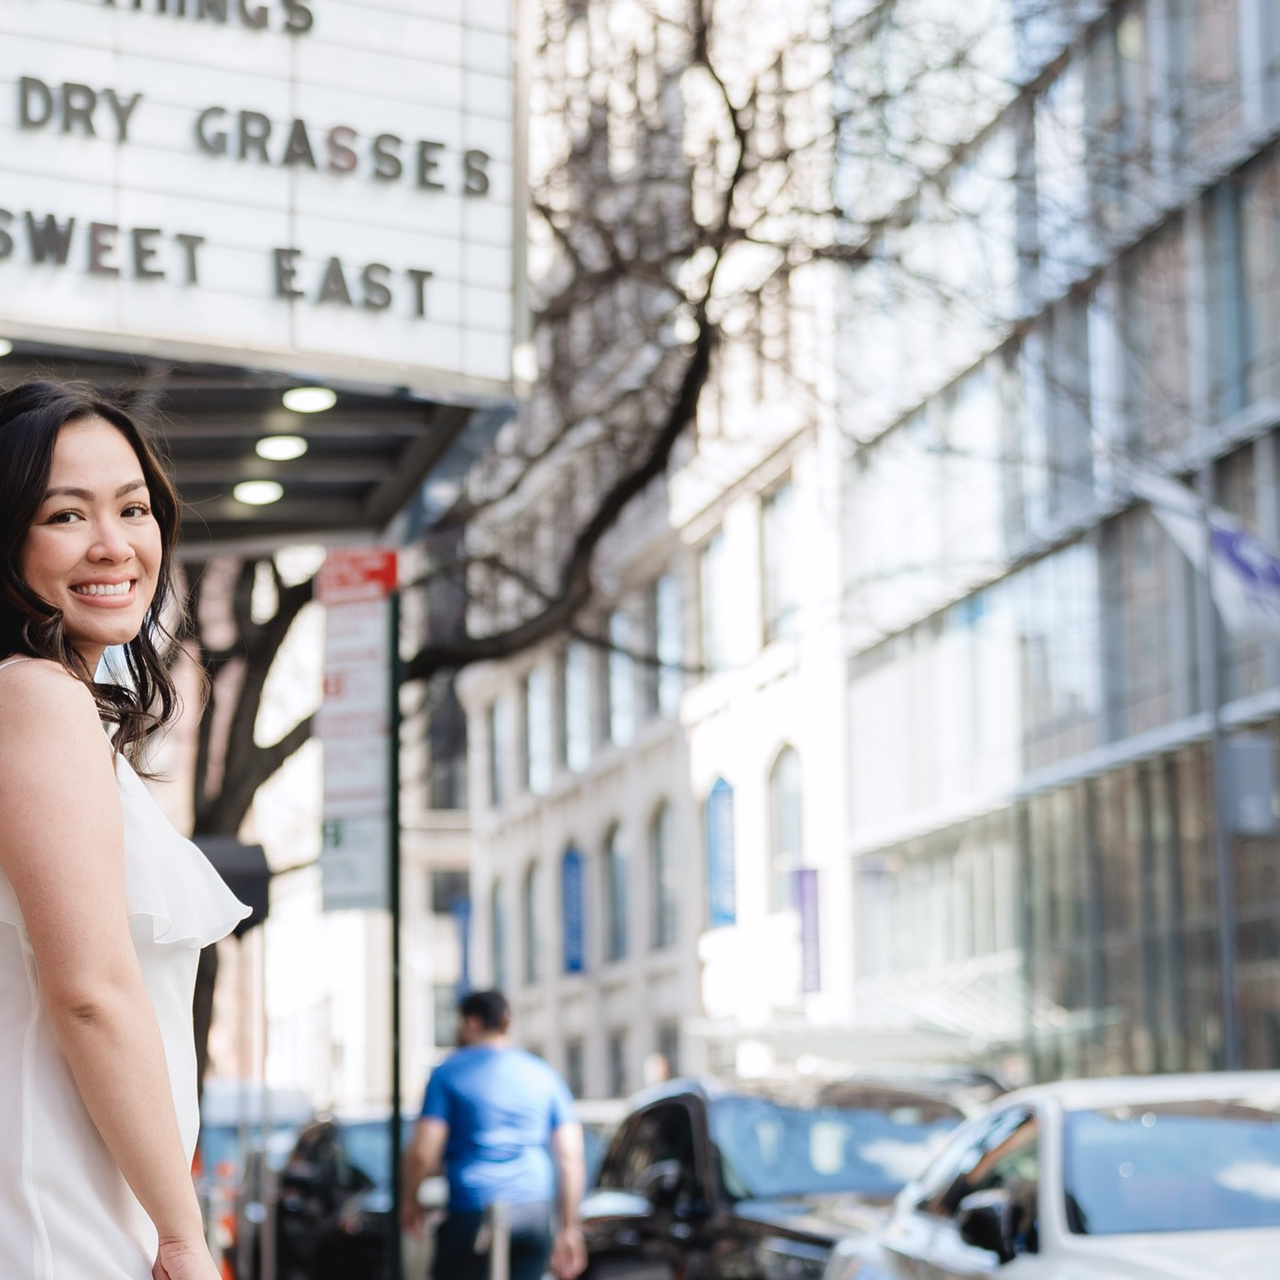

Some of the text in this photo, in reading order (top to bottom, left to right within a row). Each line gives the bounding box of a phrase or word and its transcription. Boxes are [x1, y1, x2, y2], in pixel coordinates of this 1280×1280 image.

[18, 75, 143, 142] DRY
[194, 105, 492, 198] GRASSES
[273, 247, 435, 319] EAST
